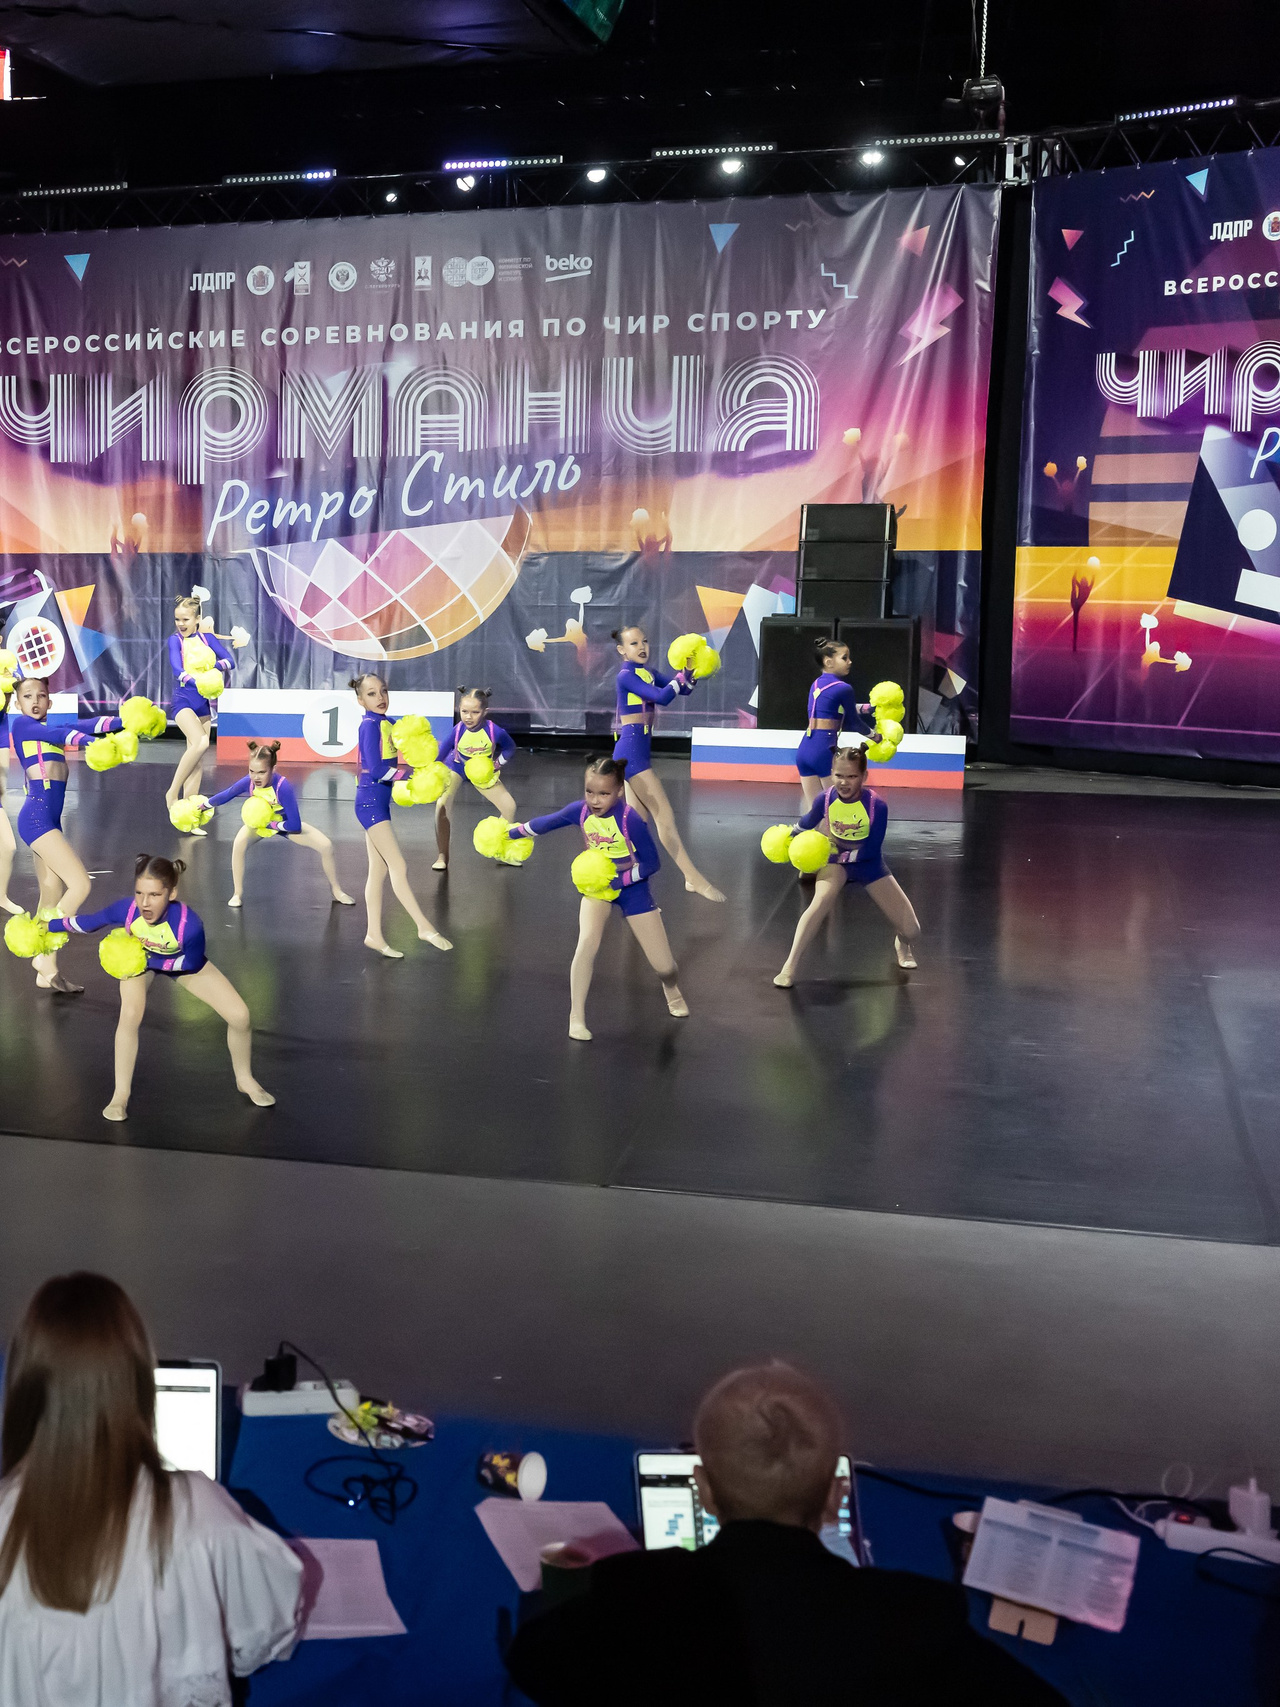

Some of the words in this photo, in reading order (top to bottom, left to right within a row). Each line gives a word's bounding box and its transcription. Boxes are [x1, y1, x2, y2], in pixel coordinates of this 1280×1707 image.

[1209, 219, 1253, 242] ЛДПР
[545, 253, 593, 271] beko
[189, 271, 236, 294] ЛДПР
[260, 319, 525, 347] СОРЕВНОВАНИЯ
[542, 317, 587, 337] ПО
[603, 314, 671, 335] ЧИР
[687, 308, 828, 332] СПОРТУ
[206, 478, 377, 546] Ретро
[400, 449, 582, 517] Стиль
[322, 706, 343, 745] 1
